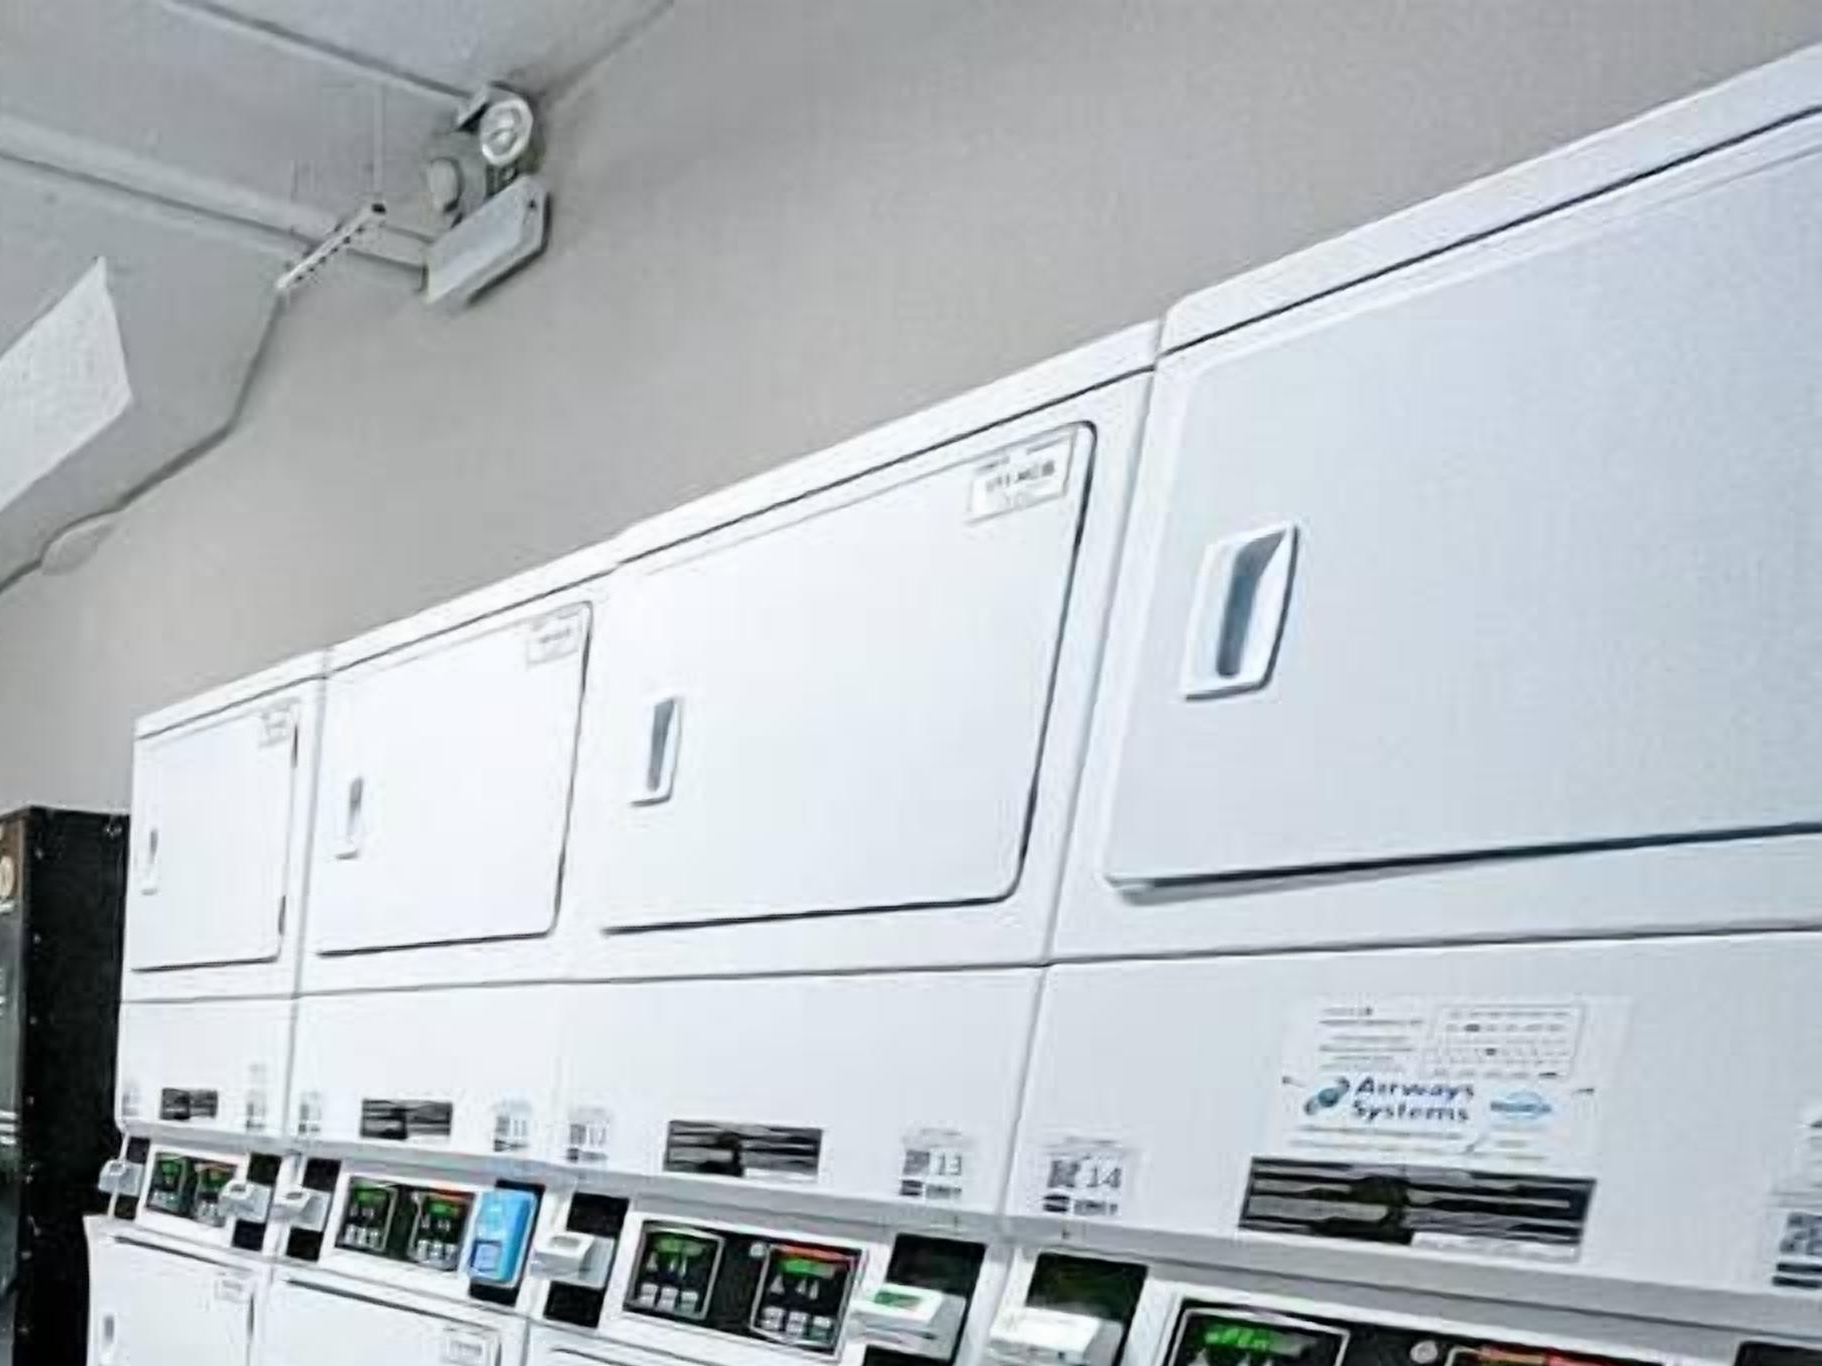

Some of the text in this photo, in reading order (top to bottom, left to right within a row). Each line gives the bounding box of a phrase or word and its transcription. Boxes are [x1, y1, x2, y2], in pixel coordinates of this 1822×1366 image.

[1355, 1077, 1474, 1102] Airways
[1352, 1099, 1469, 1122] Systems
[936, 1154, 962, 1176] 13
[1085, 1166, 1122, 1189] 14
